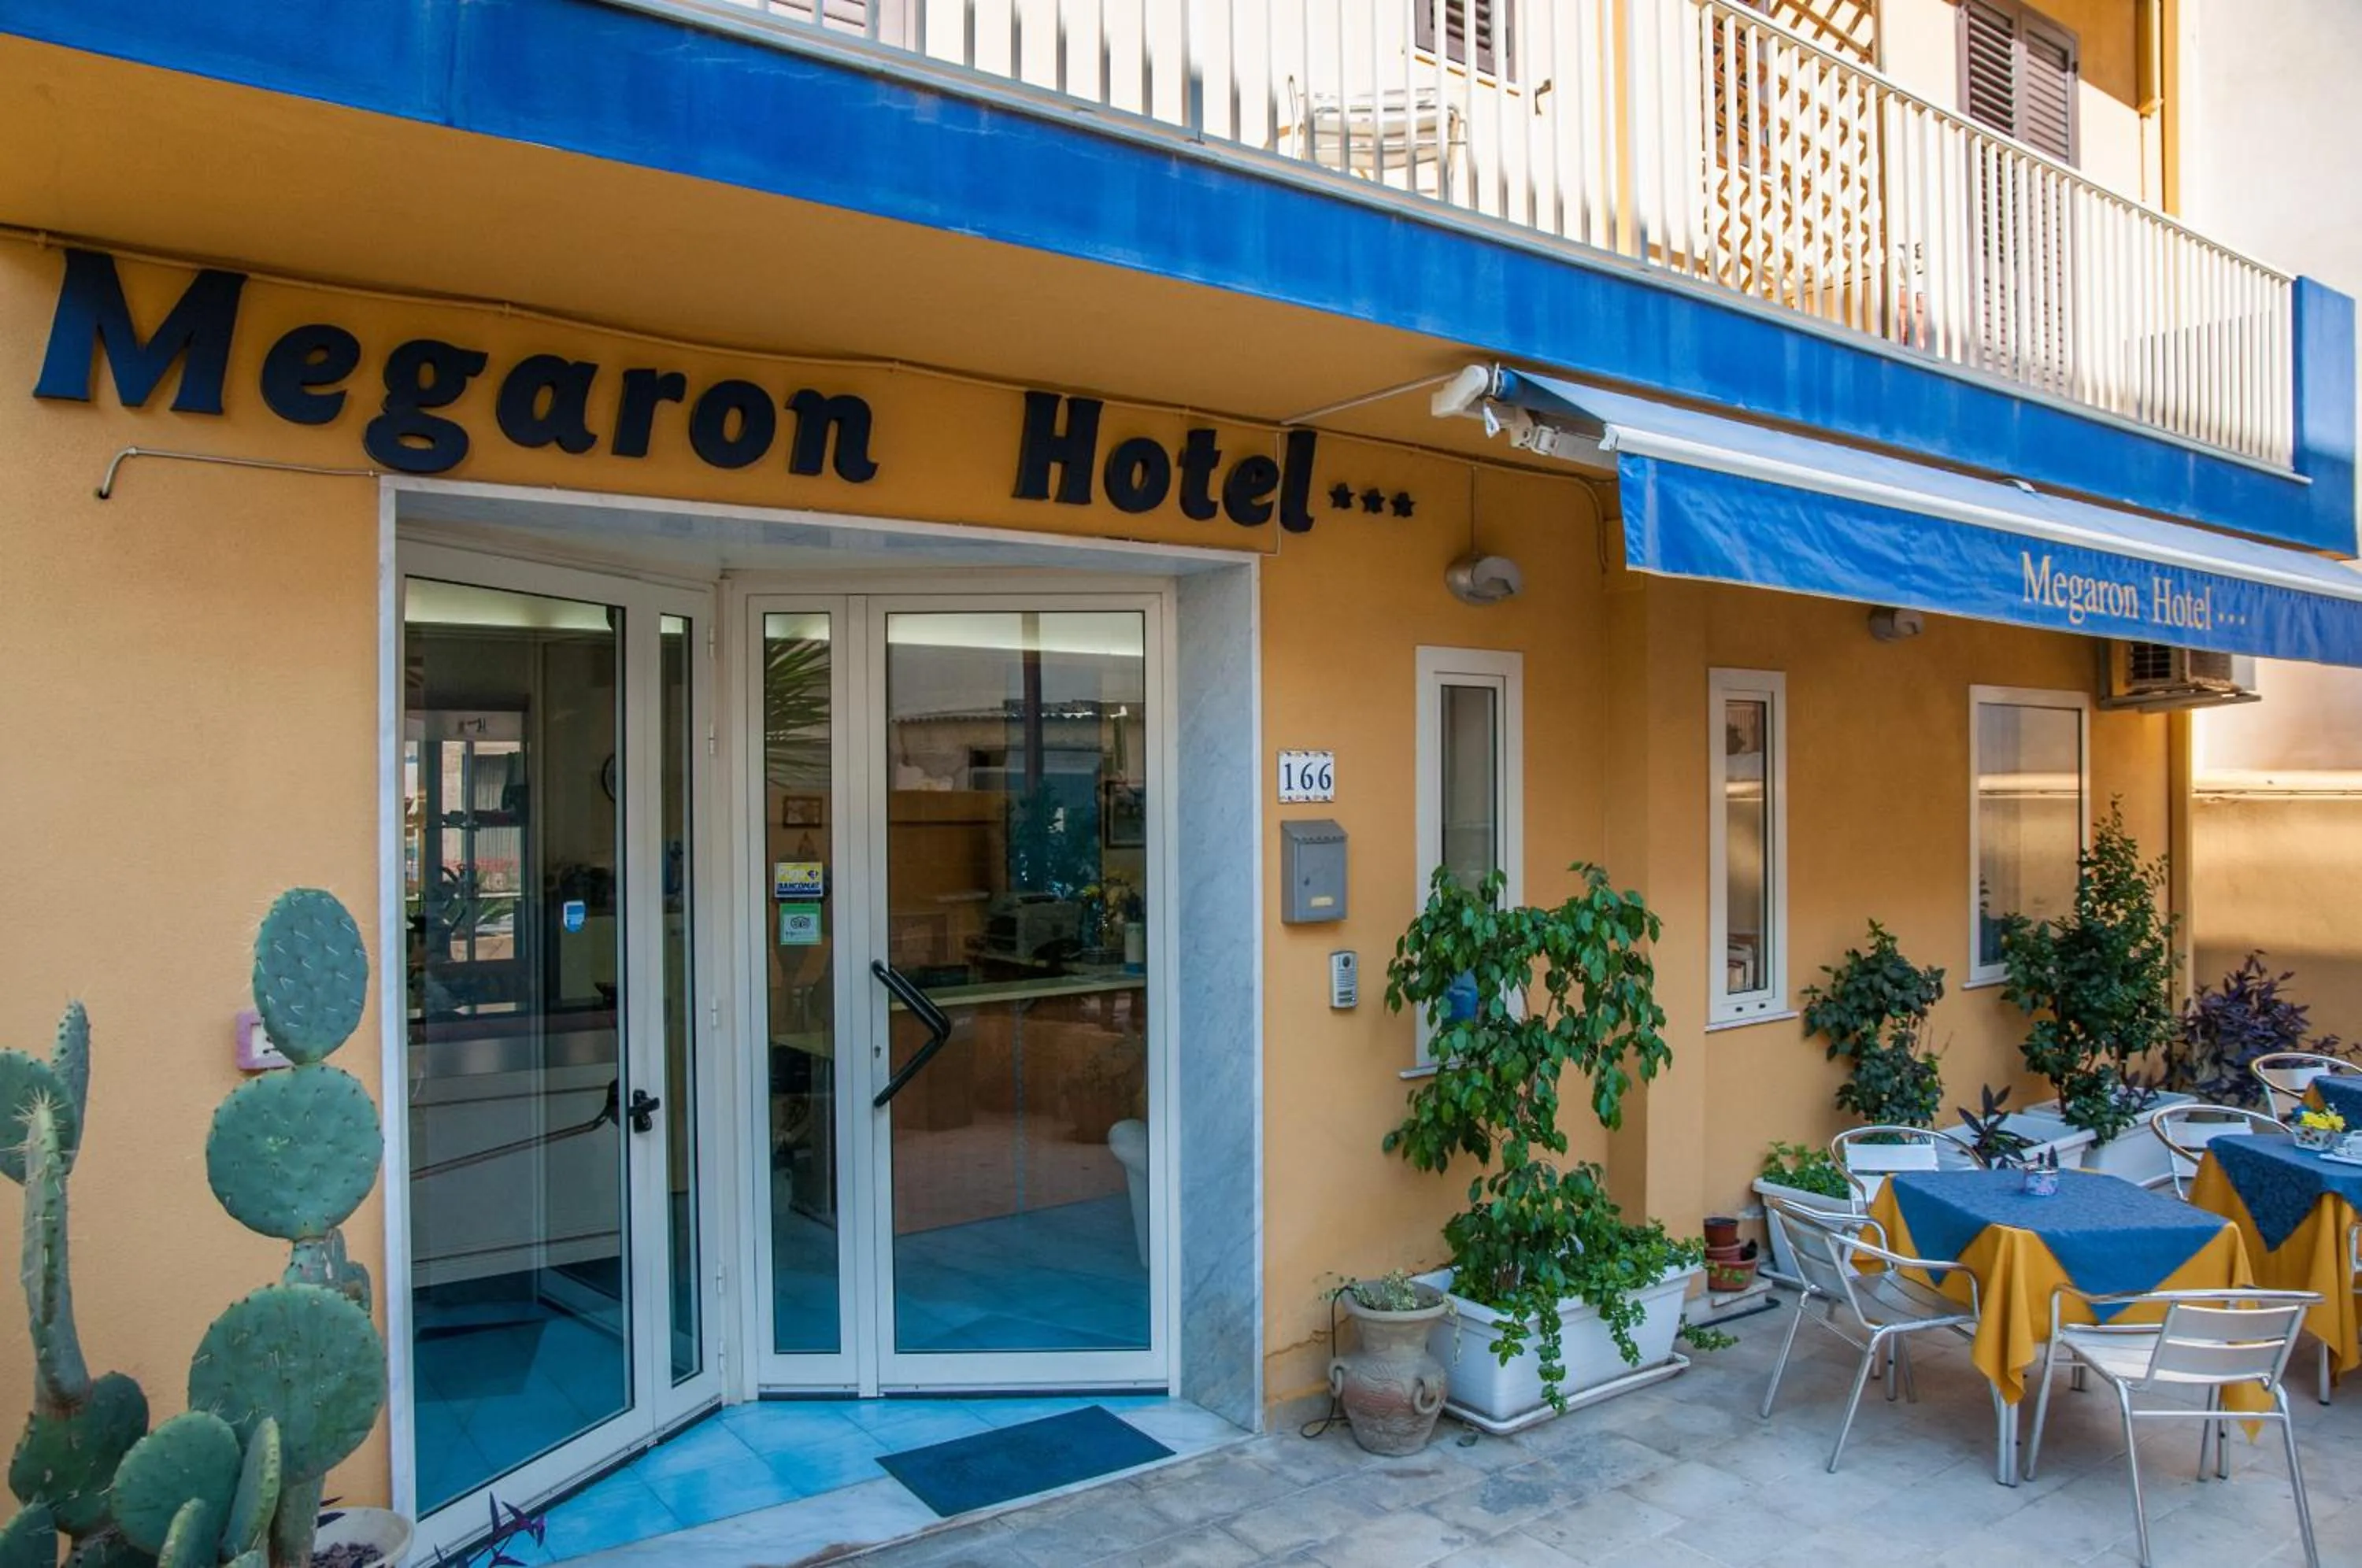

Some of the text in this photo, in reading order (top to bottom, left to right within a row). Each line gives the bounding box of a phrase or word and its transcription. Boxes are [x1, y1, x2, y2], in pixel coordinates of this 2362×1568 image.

[34, 249, 1318, 533] Megaron Hotel
[2020, 551, 2212, 630] Megaron Hotel
[1284, 762, 1332, 791] 166
